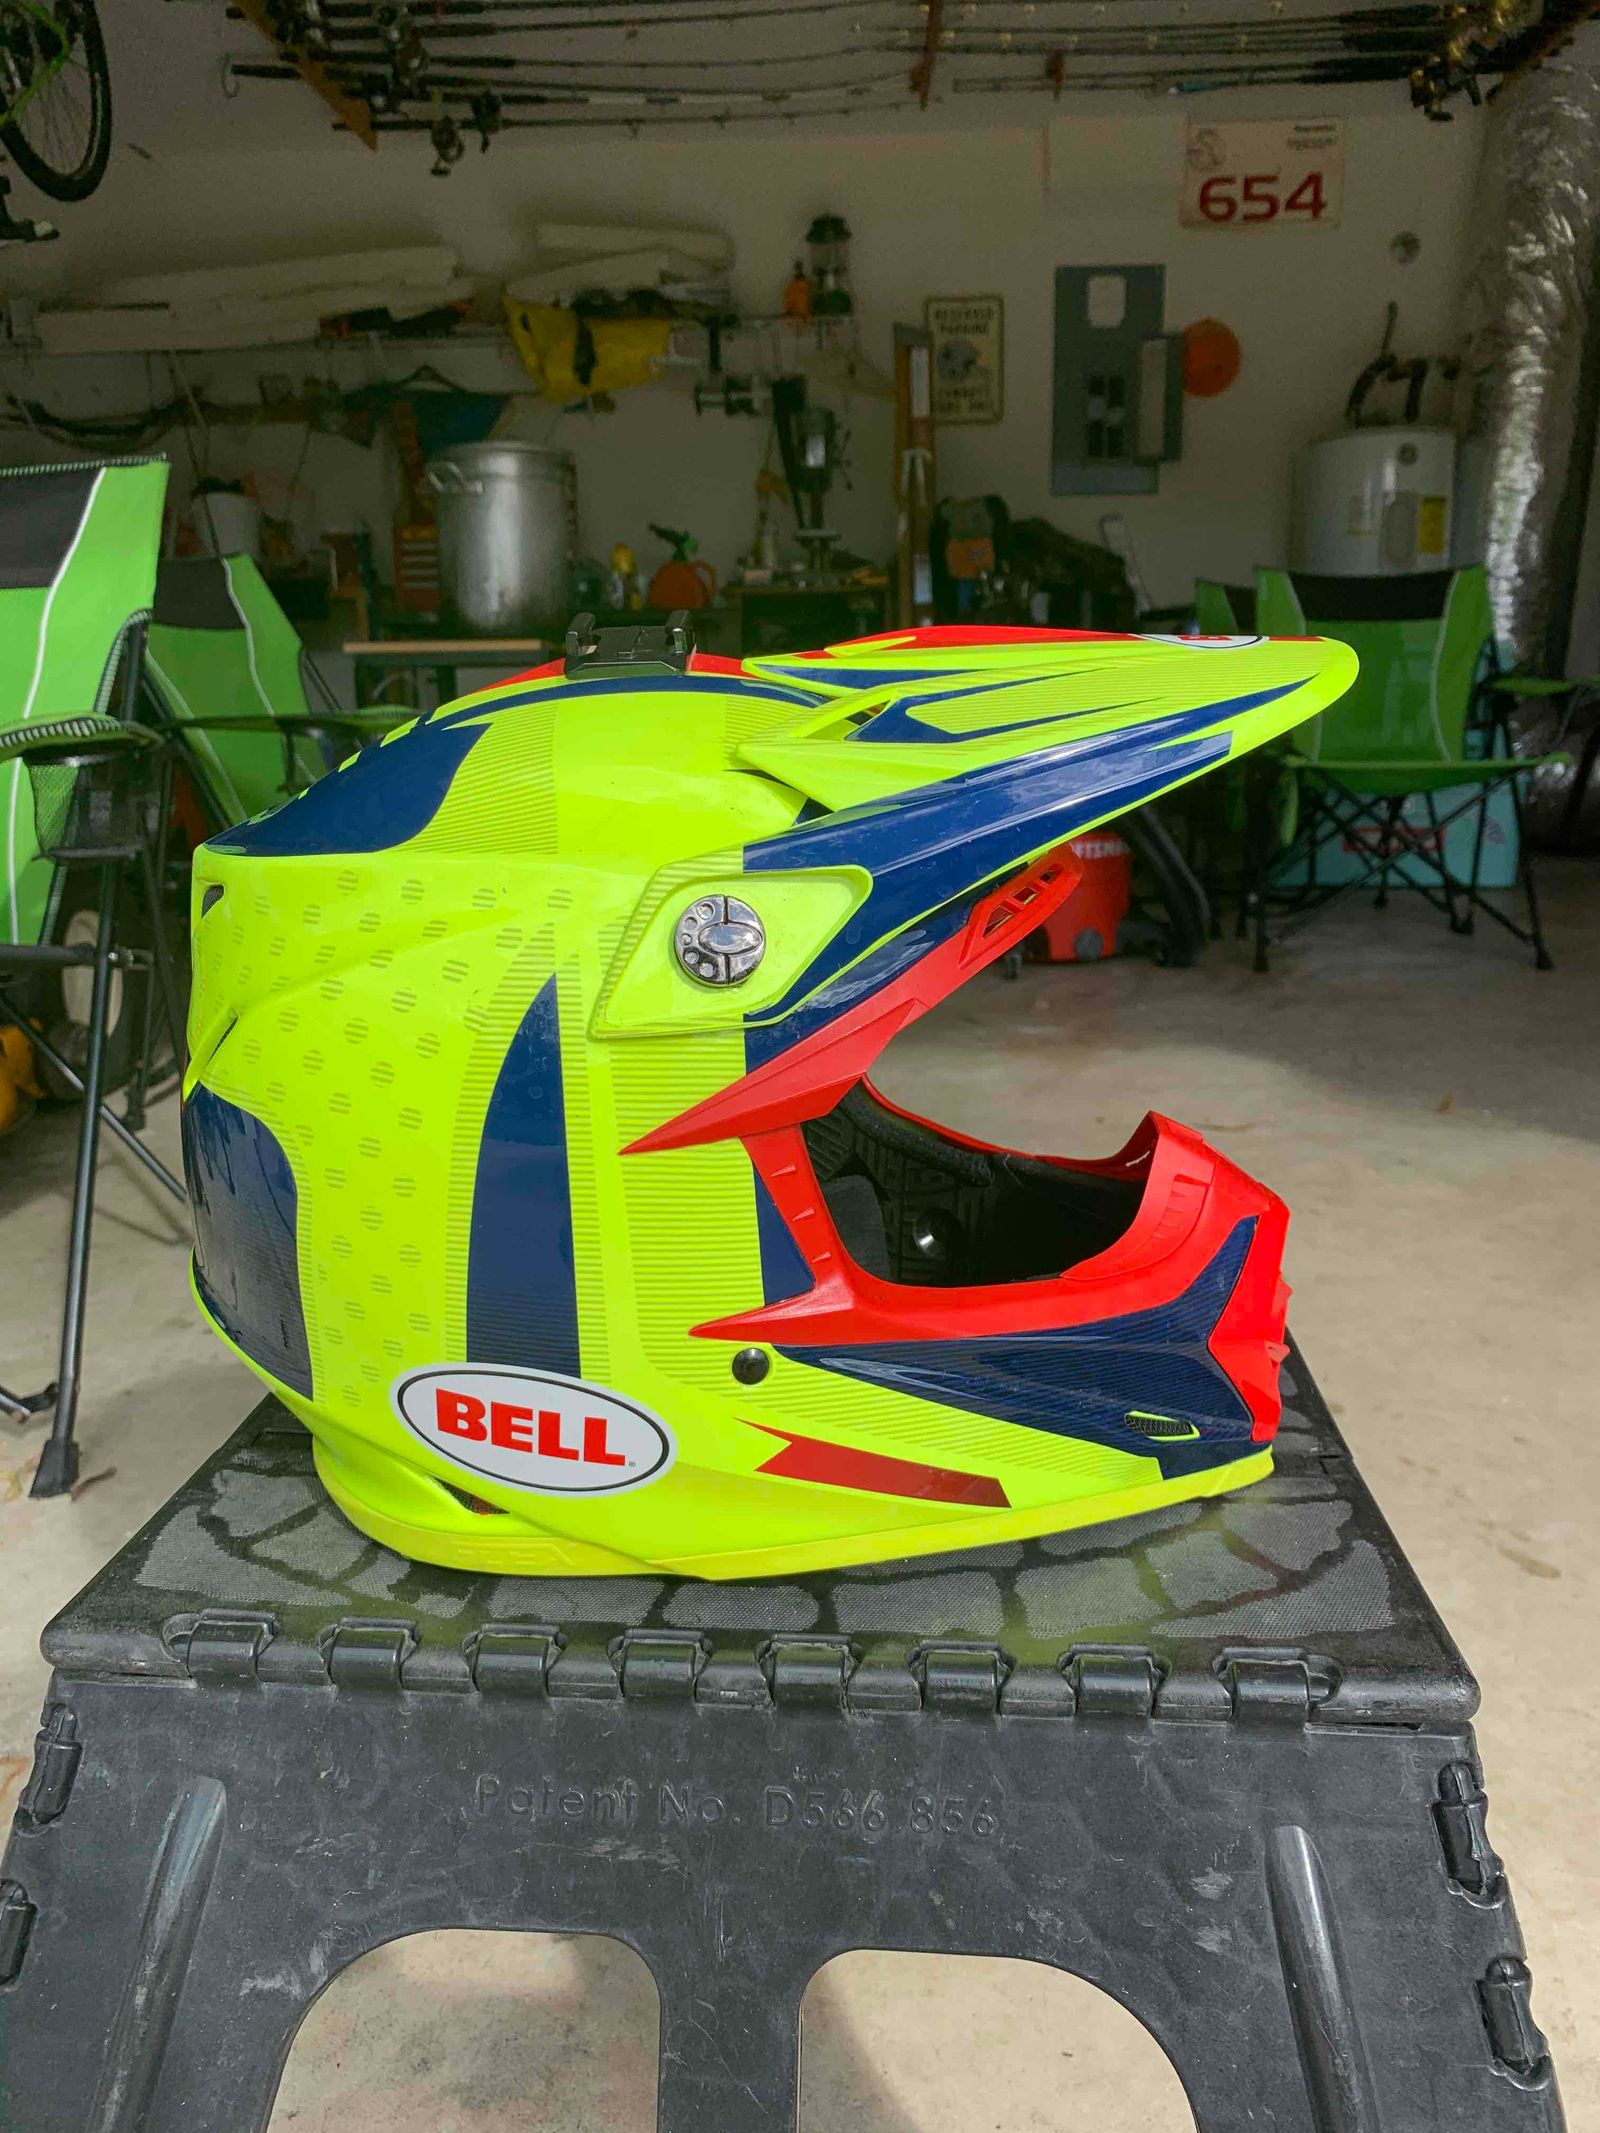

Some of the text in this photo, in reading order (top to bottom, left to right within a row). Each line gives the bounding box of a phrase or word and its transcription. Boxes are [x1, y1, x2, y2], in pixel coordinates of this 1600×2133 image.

[1199, 171, 1326, 222] 654
[436, 1387, 626, 1467] BELL
[475, 1773, 637, 1823] Patent
[659, 1780, 742, 1824] No.
